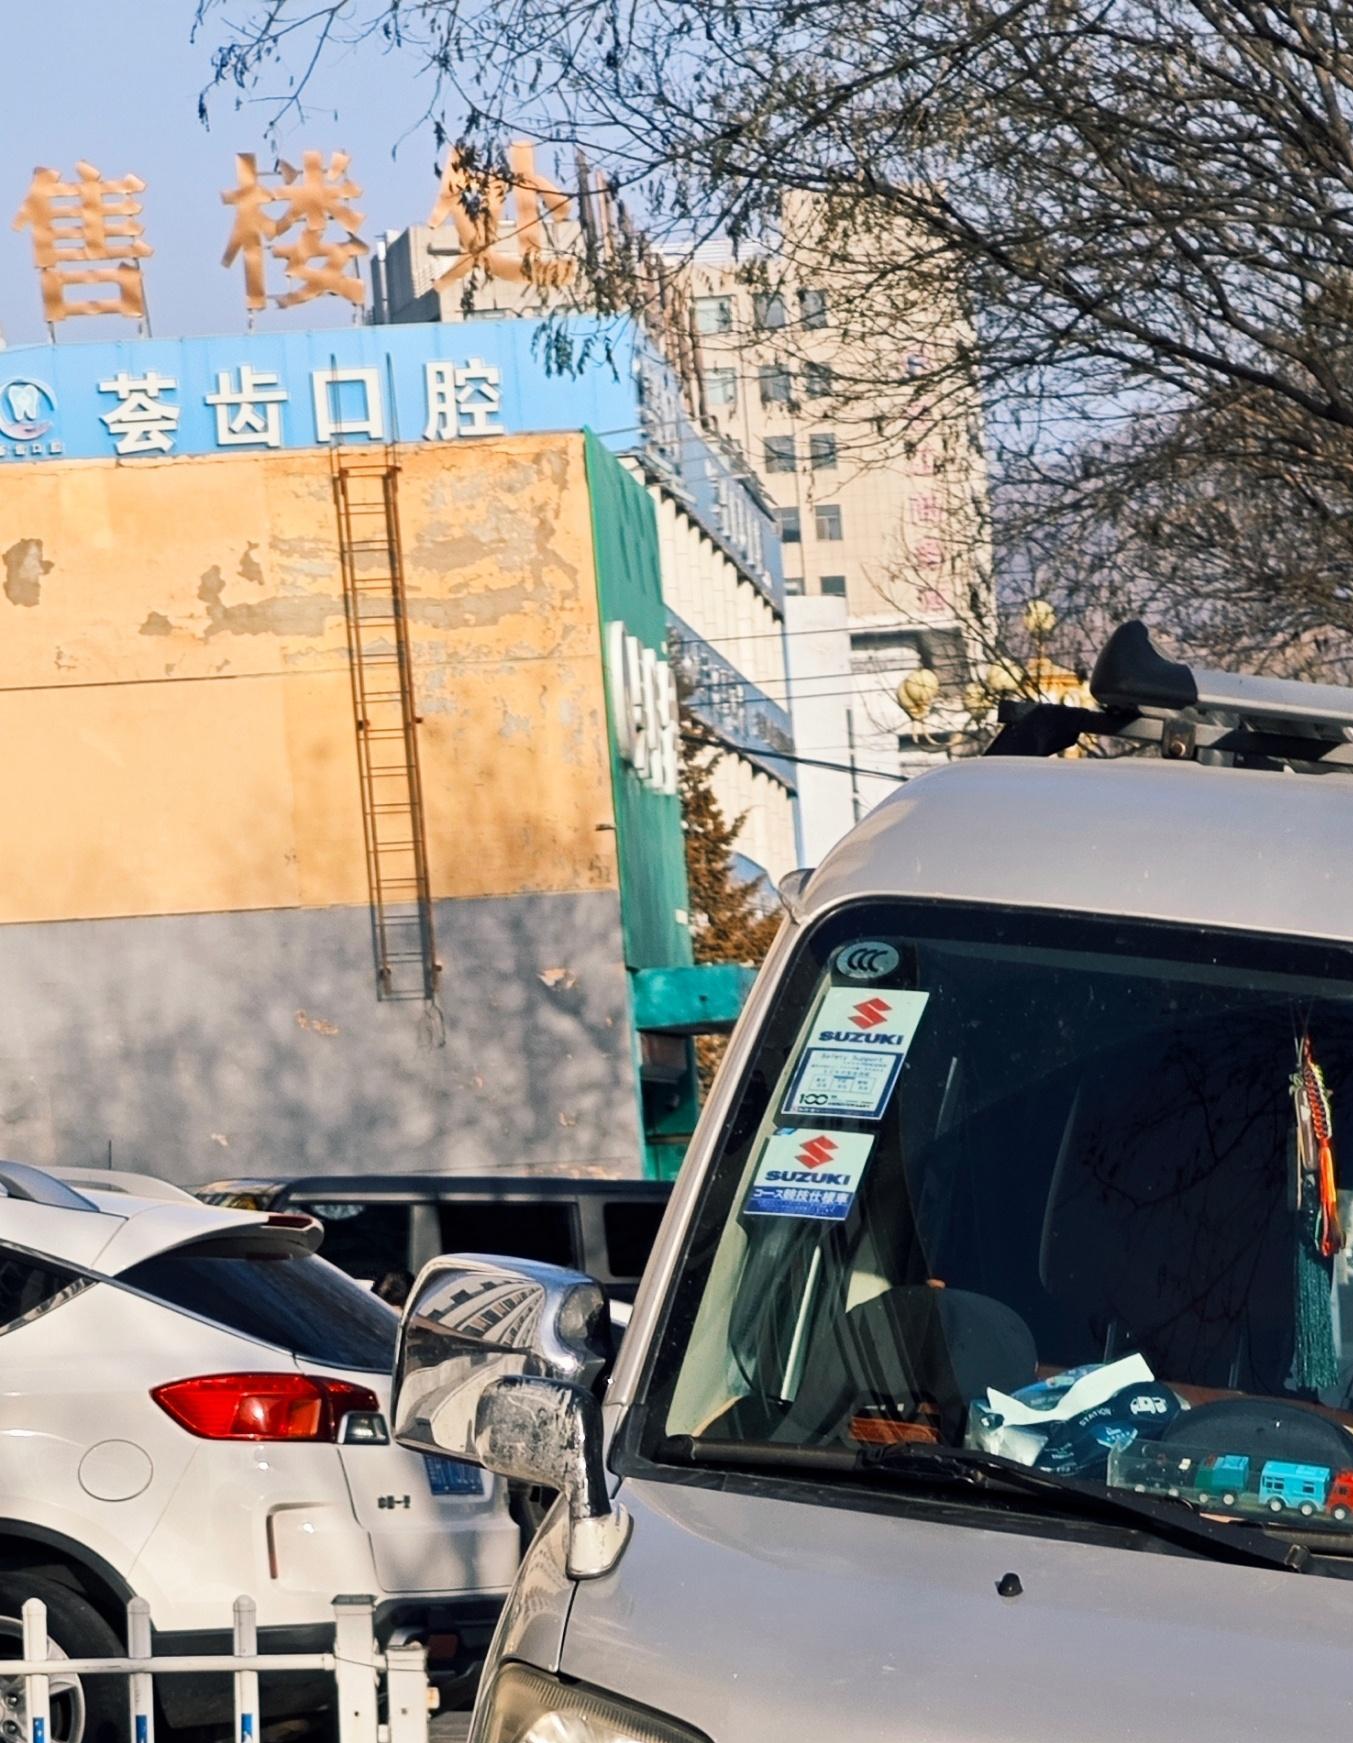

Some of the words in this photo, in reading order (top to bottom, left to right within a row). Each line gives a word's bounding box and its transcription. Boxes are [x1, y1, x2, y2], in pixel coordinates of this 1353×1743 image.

[98, 357, 503, 454] 荟齿口腔
[818, 1030, 904, 1046] SUZUKI
[765, 1170, 851, 1186] SUZUKI
